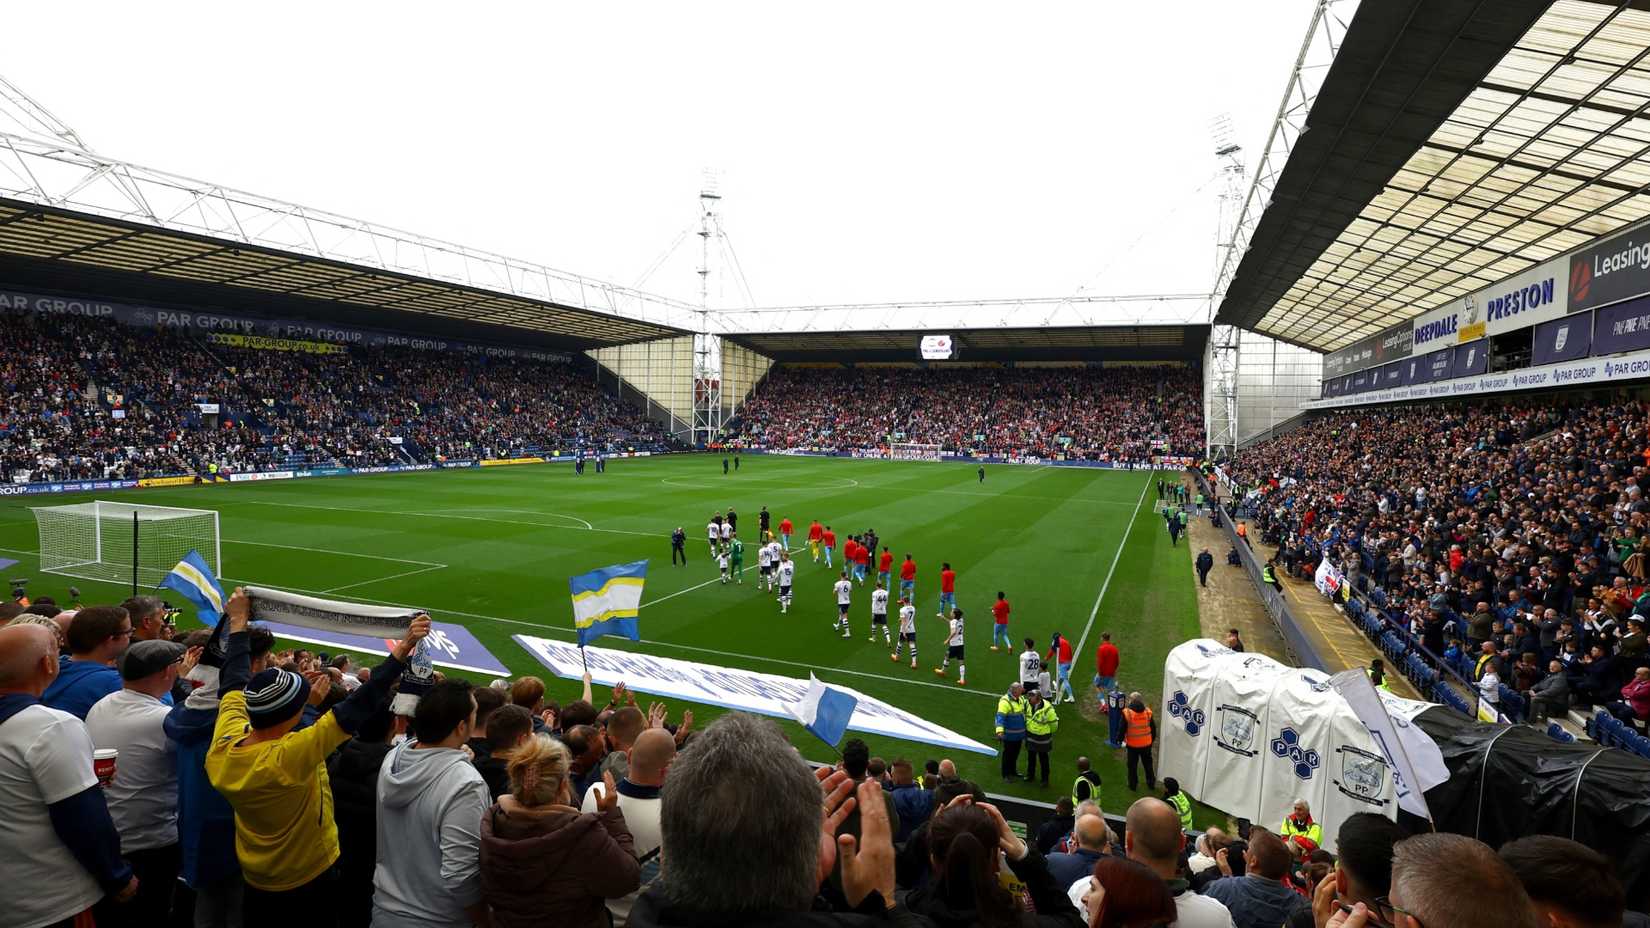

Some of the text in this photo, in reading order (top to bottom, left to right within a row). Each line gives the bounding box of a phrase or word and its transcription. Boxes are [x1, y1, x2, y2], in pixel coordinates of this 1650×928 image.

[36, 299, 113, 317] GROUP
[1487, 278, 1554, 322] PRESTON
[158, 312, 191, 326] PAR
[1414, 314, 1458, 345] DEEPDALE
[1519, 376, 1528, 384] PAR
[1529, 373, 1547, 384] GROUP
[1560, 370, 1572, 381] PAR
[1573, 367, 1596, 379] GROUP
[1614, 363, 1629, 374] PAR
[1631, 360, 1650, 373] GRO
[1027, 659, 1040, 670] 28
[1171, 705, 1203, 723] PAR
[1276, 743, 1317, 767] PAR
[1355, 783, 1369, 795] PP
